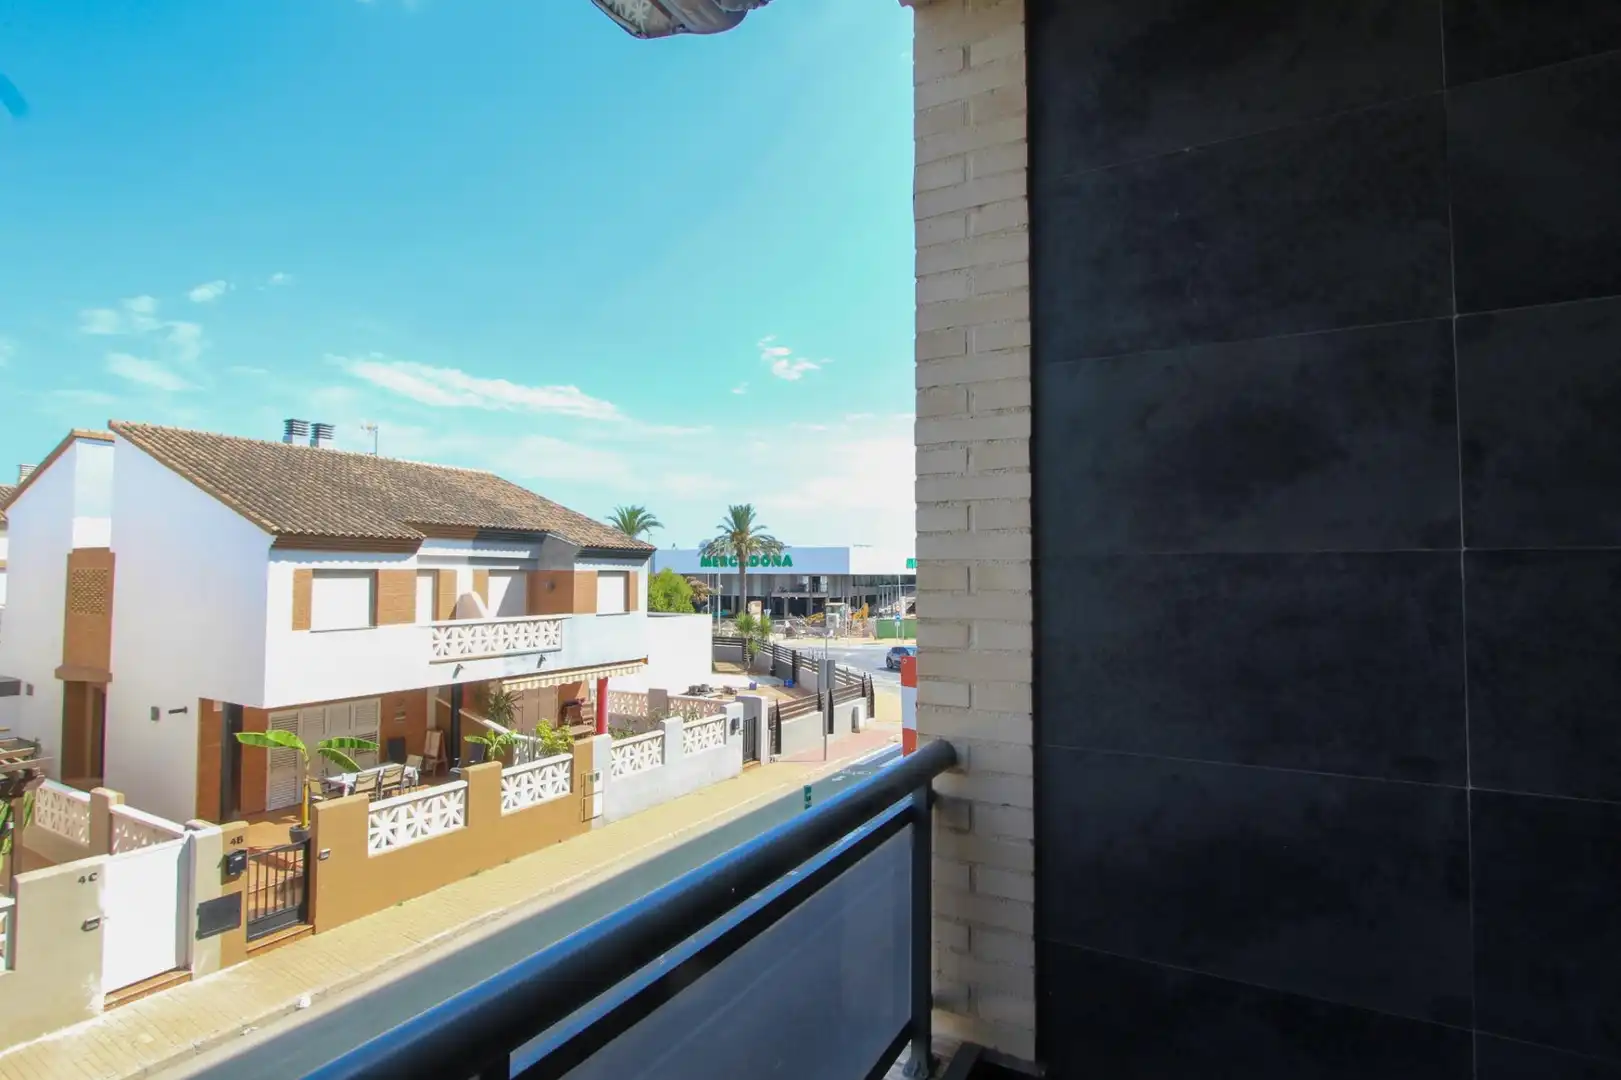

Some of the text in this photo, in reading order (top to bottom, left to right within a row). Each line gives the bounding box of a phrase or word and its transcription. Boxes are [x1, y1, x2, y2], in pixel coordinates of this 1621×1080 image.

[700, 554, 793, 568] MERCDONA
[229, 835, 244, 846] 4B
[78, 872, 98, 884] 4C
